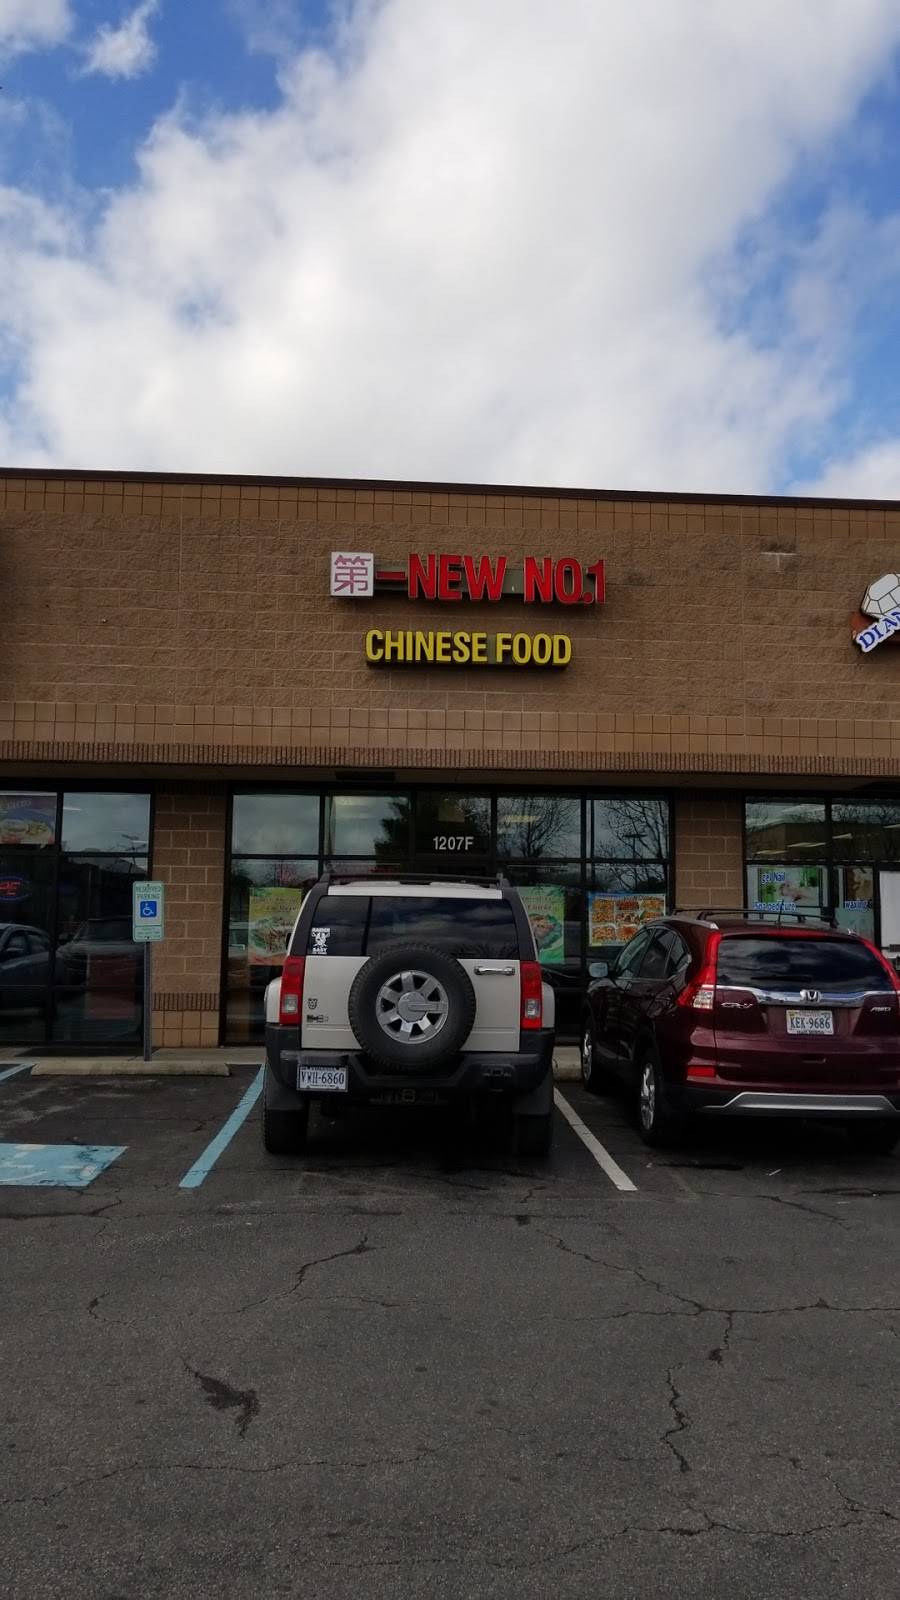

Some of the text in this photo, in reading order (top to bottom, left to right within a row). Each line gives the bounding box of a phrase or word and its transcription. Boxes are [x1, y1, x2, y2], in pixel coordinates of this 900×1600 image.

[408, 553, 606, 605] NEW NO.1
[365, 629, 572, 665] CHINESE FOOD
[858, 611, 900, 650] DIA
[432, 836, 475, 851] 1207F
[790, 1017, 831, 1029] KEK-9686
